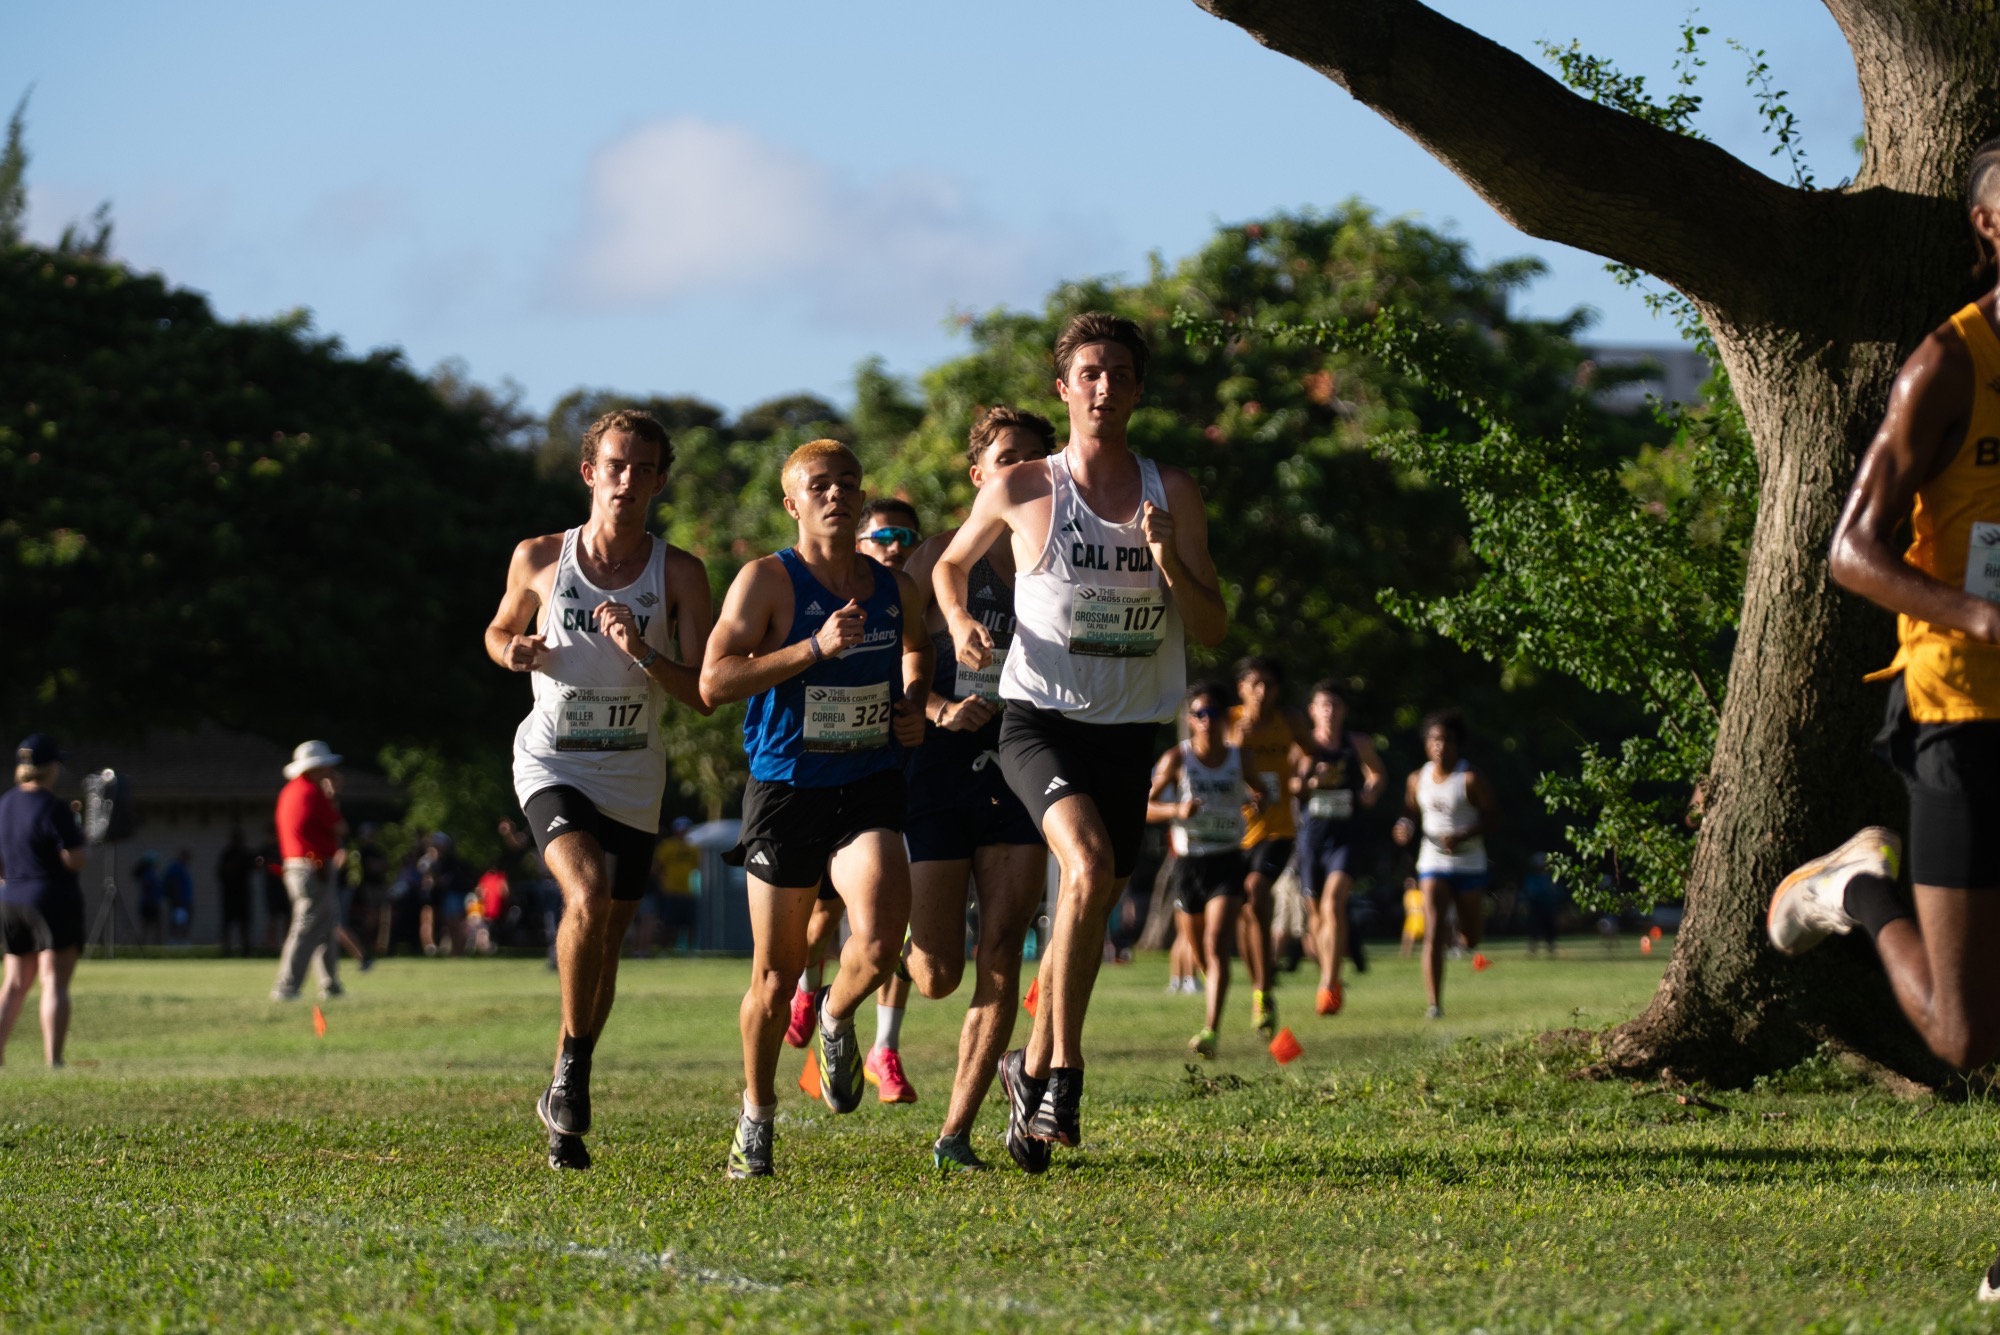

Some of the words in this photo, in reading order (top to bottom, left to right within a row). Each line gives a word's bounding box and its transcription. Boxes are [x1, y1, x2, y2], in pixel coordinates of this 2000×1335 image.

[1072, 543, 1109, 570] CAL
[1098, 588, 1116, 596] THE
[1097, 595, 1121, 603] CROSS
[1122, 596, 1152, 604] COUNTRY
[563, 607, 598, 634] CAL
[1074, 611, 1120, 624] GROSSMAN
[1123, 605, 1166, 631] 107
[1086, 631, 1155, 641] CHAMPIONSHIPS
[829, 688, 845, 696] THE
[827, 695, 851, 703] CROSS
[852, 694, 878, 702] COUNTRY
[566, 711, 594, 721] MILLER
[608, 703, 644, 727] 117
[812, 711, 846, 723] CORREIA
[852, 701, 889, 728] 322
[570, 727, 637, 737] CHAMPIONSHIPS
[819, 726, 881, 739] CHAMPIONSHIPS
